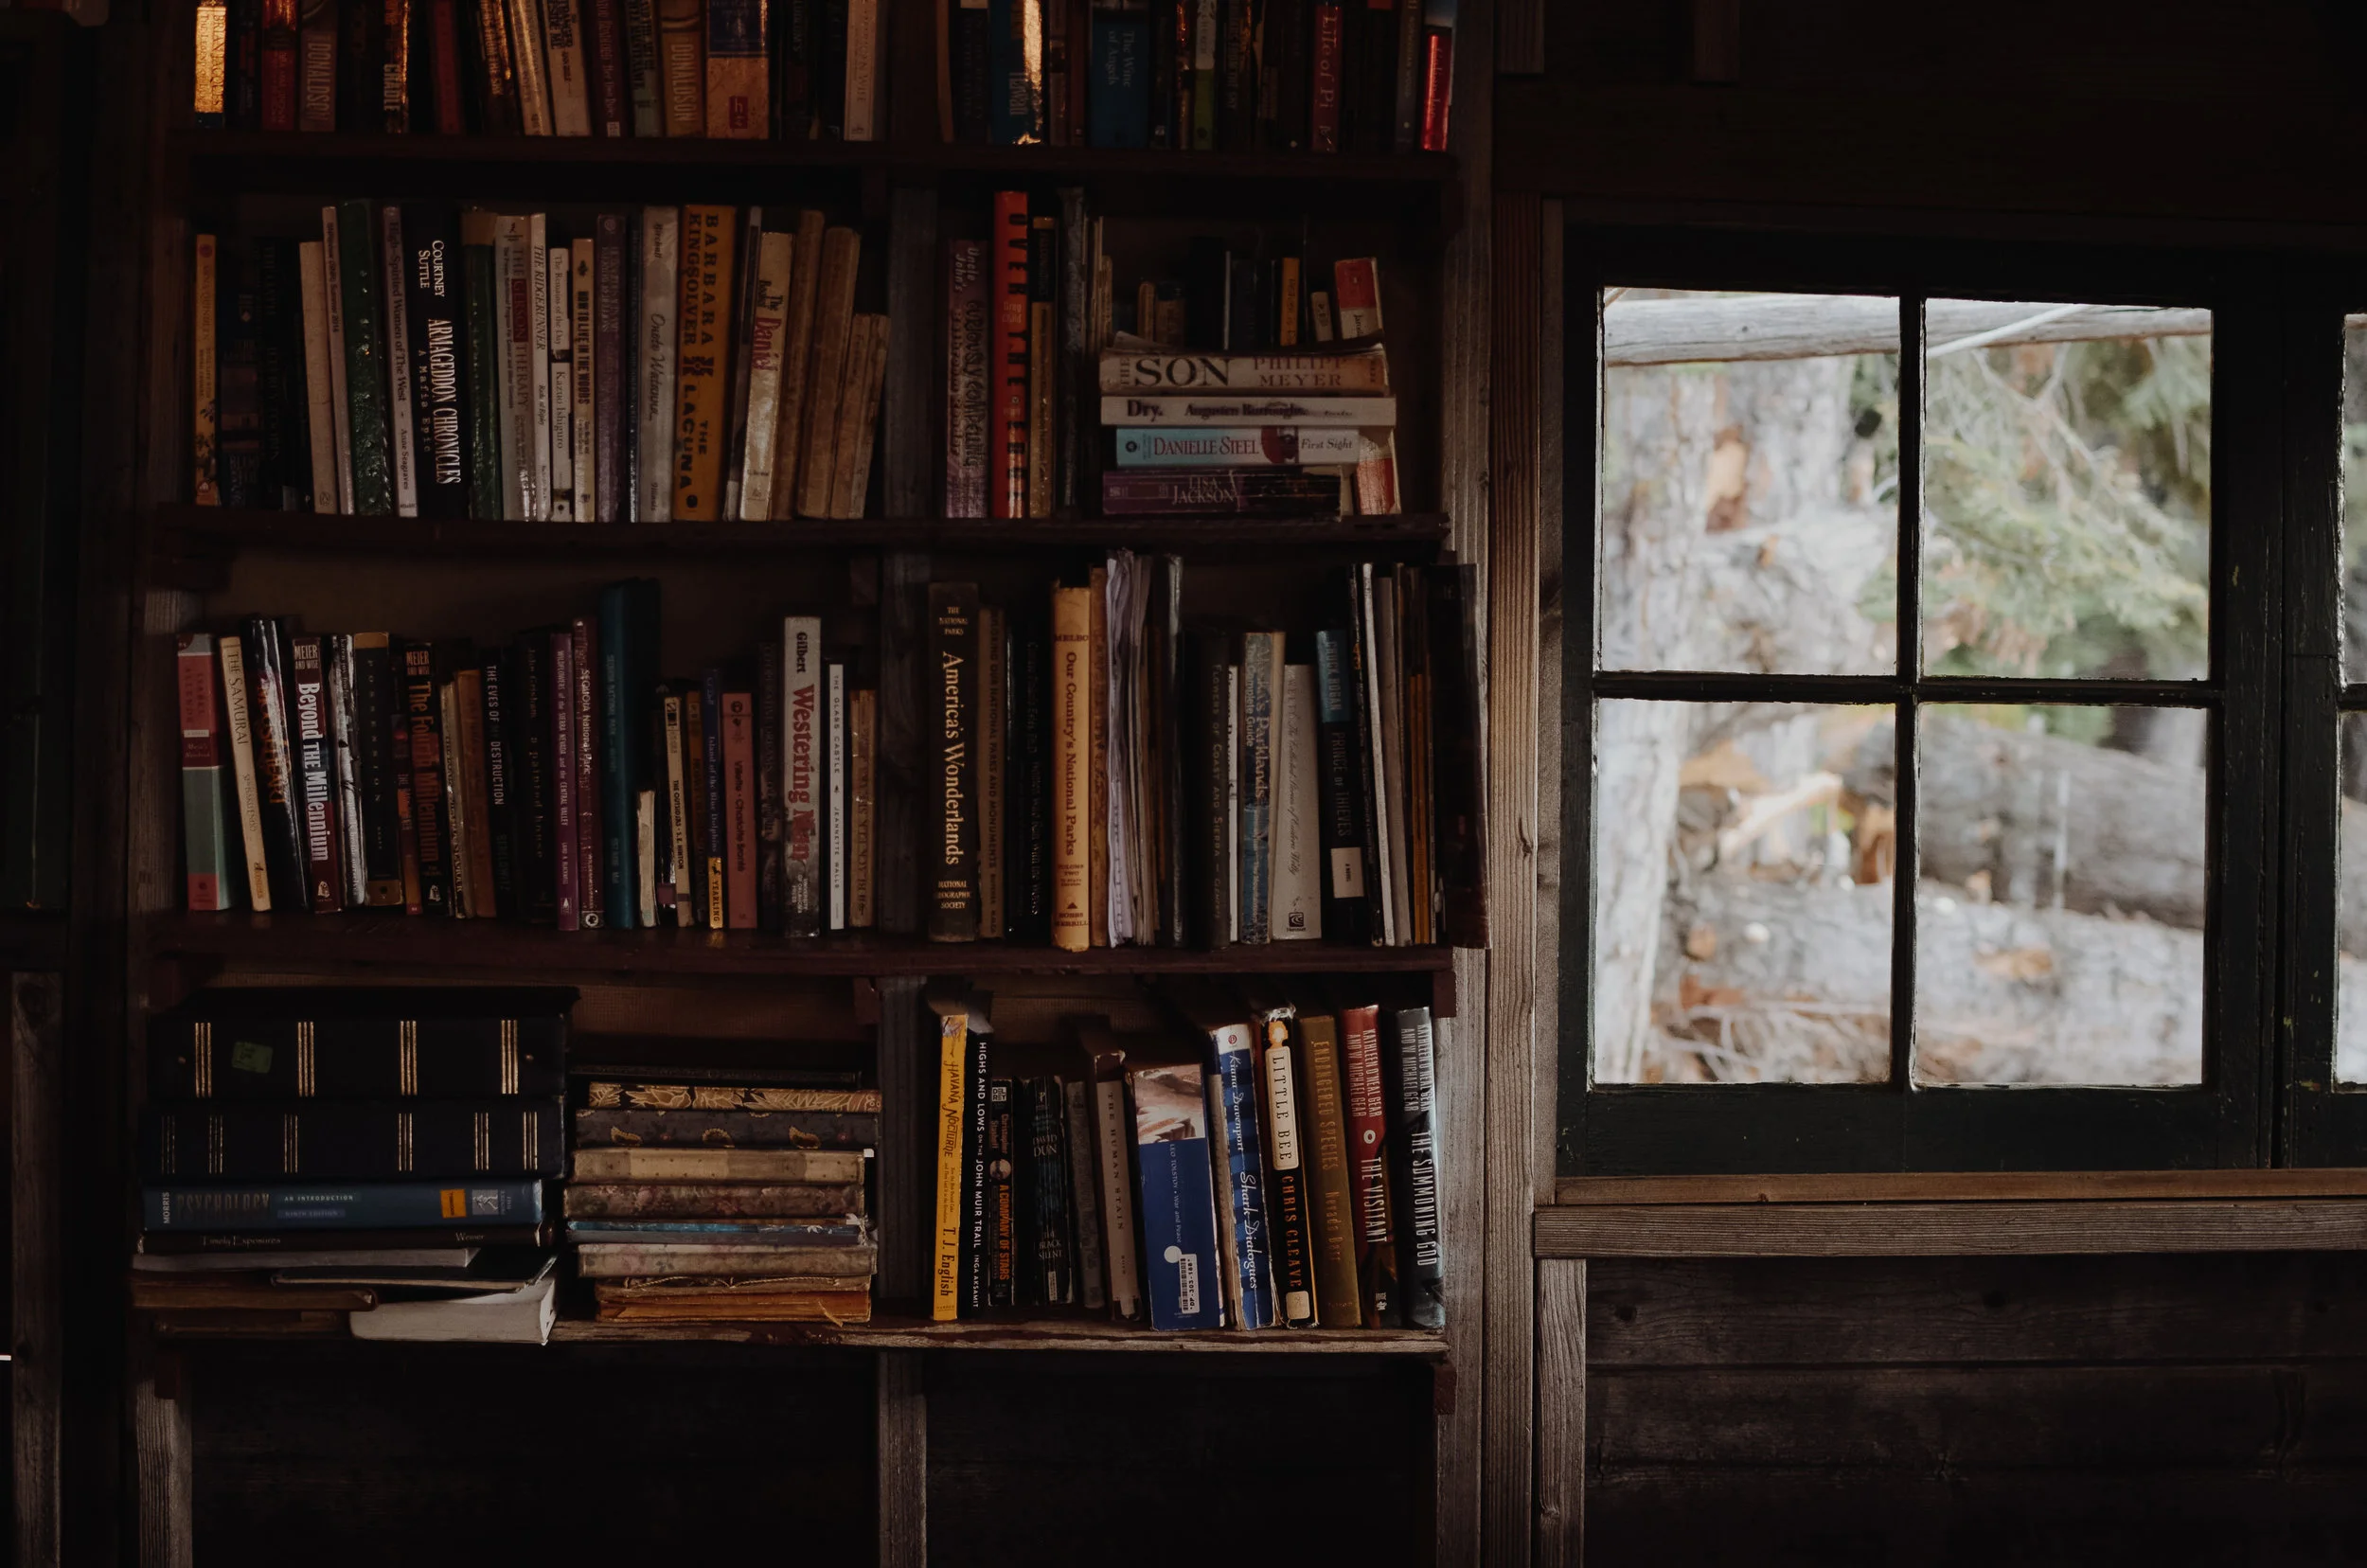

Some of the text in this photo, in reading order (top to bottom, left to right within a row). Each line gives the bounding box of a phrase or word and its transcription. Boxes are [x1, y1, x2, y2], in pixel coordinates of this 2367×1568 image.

[209, 14, 224, 106] BRIAN JACQUES
[306, 43, 331, 120] DONALDSON
[670, 44, 698, 121] DONALDSON
[1105, 31, 1119, 86] of Angels
[1122, 31, 1135, 88] The Wine
[1319, 14, 1338, 108] Life of Pi
[383, 62, 400, 112] CRADLE
[418, 249, 432, 289] SUTTLE
[432, 240, 447, 298] COURTNEY
[512, 247, 525, 277] THE
[683, 213, 702, 346] KINGSOLVER
[702, 214, 719, 346] BARBARA
[952, 253, 968, 294] John's
[966, 246, 983, 281] Uncle
[388, 222, 407, 402] High-Spirited Women of The West
[513, 280, 527, 340] GERSON
[534, 244, 546, 350] THE RIDGERUNNER
[578, 291, 591, 310] HOW
[578, 312, 590, 322] TO
[578, 323, 590, 343] LIVE
[578, 345, 590, 354] IN
[752, 317, 783, 372] Daniel
[515, 343, 530, 408] THERAPY
[578, 356, 591, 372] THE
[1134, 356, 1233, 386] SON
[1253, 356, 1344, 370] PHILIPP
[1258, 374, 1343, 387] MEYER
[428, 318, 461, 485] ARMAGEDDON CHRONICLES
[554, 371, 567, 449] Kazuo Ishiguro
[578, 373, 591, 404] WOODS
[680, 383, 697, 490] LACUNA
[699, 419, 709, 454] THE
[1154, 436, 1260, 455] DANIELLE STEEL
[1301, 437, 1354, 452] First Sight
[1171, 484, 1237, 506] JACKSON
[294, 644, 319, 659] MEIER
[557, 650, 566, 690] WILDFLOWERS
[796, 632, 809, 674] Gilbert
[1325, 640, 1343, 711] CHUCK HOGAN
[227, 650, 249, 746] THE SAMURAI
[486, 665, 505, 806] THE EVES OF DESTRUCTION
[559, 734, 567, 755] NEVADA
[789, 684, 815, 804] Westering
[942, 650, 966, 865] America's Wonderlands
[1062, 651, 1077, 856] Our Country's National Parks
[1255, 716, 1271, 799] Parklands
[297, 682, 329, 861] Beyond THE Millennium
[409, 681, 441, 863] The Fourth Millennium
[559, 757, 567, 767] and
[1212, 664, 1224, 858] FLOWERS OF COAST AND SIERRA
[1331, 732, 1352, 838] PRINCE OF THIEVES
[560, 781, 568, 805] CENTRAL
[561, 807, 569, 826] VALLEY
[707, 736, 720, 852] Island of the Blue Dolphins
[712, 880, 721, 921] YEARLING
[978, 1042, 987, 1074] HIGHS
[1346, 1034, 1361, 1049] AND
[1349, 1062, 1364, 1096] MICHAEL
[1361, 1028, 1383, 1117] KATHLEEN O'NEAL GEAR
[942, 1060, 963, 1158] HAVANA NOCTURNE
[976, 1103, 986, 1132] LOWS
[1229, 1055, 1246, 1151] Kiana Davenport
[1272, 1055, 1293, 1162] LITTLE BEE
[1311, 1040, 1340, 1171] ENDANGERED SPECIES
[1352, 1096, 1367, 1117] GEAR
[975, 1159, 985, 1186] JOHN
[1107, 1092, 1125, 1232] THE HUMAN STAIN
[161, 1190, 171, 1224] MORRIS
[296, 1193, 355, 1202] INTRODUCTION
[974, 1190, 984, 1217] MUIR
[999, 1191, 1010, 1238] COMPANY
[1169, 1143, 1184, 1243] LEO TOLSTOY War and Peace
[1361, 1155, 1388, 1244] THE VISITANT
[1411, 1131, 1438, 1267] THE SUMMONING GOD
[942, 1226, 956, 1236] T.
[942, 1238, 956, 1250] J.
[973, 1219, 983, 1248] TRAIL
[1000, 1239, 1010, 1250] OF
[1239, 1171, 1263, 1290] Shark Dialogues
[1280, 1174, 1304, 1288] CHRIS CLEAVE
[937, 1254, 955, 1296] English
[1000, 1252, 1010, 1280] STARS
